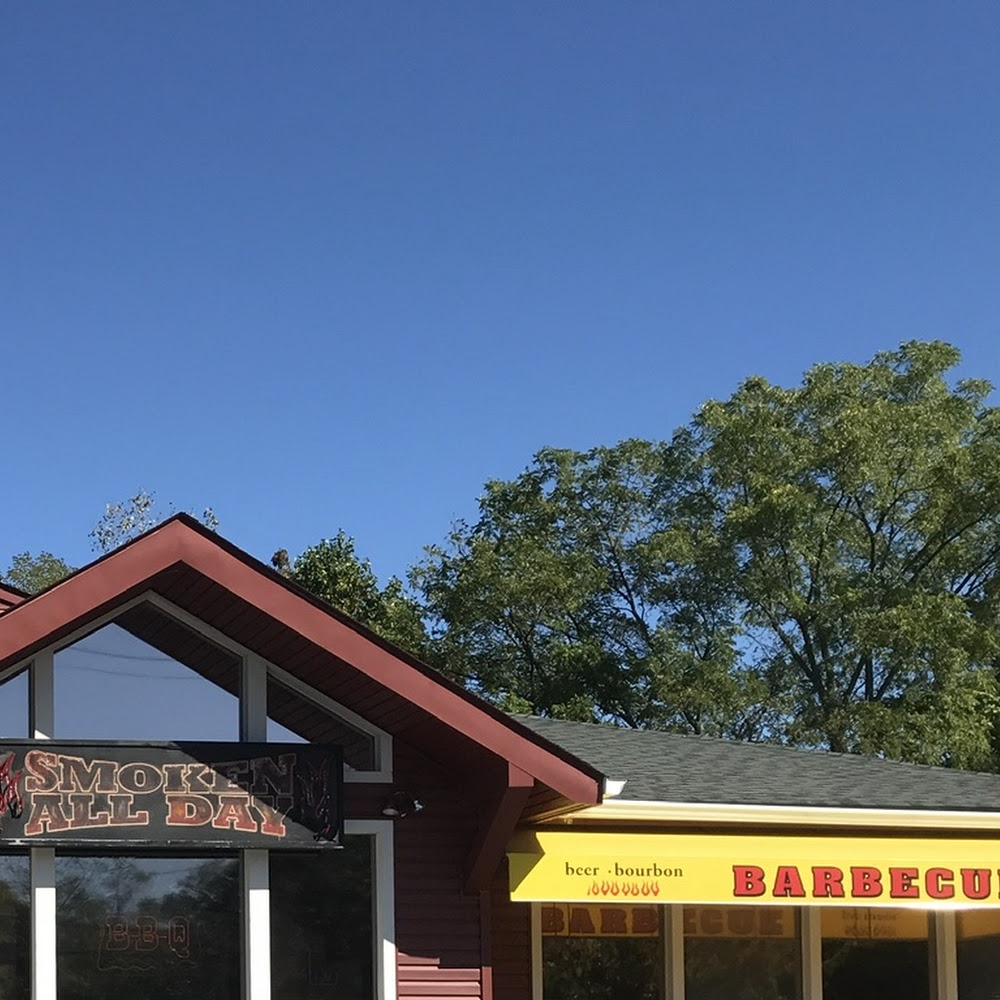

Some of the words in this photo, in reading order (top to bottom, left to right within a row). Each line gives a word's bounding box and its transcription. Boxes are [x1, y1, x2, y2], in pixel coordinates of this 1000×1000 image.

[25, 750, 297, 795] SMOKEN
[24, 793, 149, 837] ALL
[166, 794, 294, 837] DAY
[565, 862, 599, 876] beer
[615, 862, 683, 877] bourbon
[732, 865, 1000, 900] BARBECU
